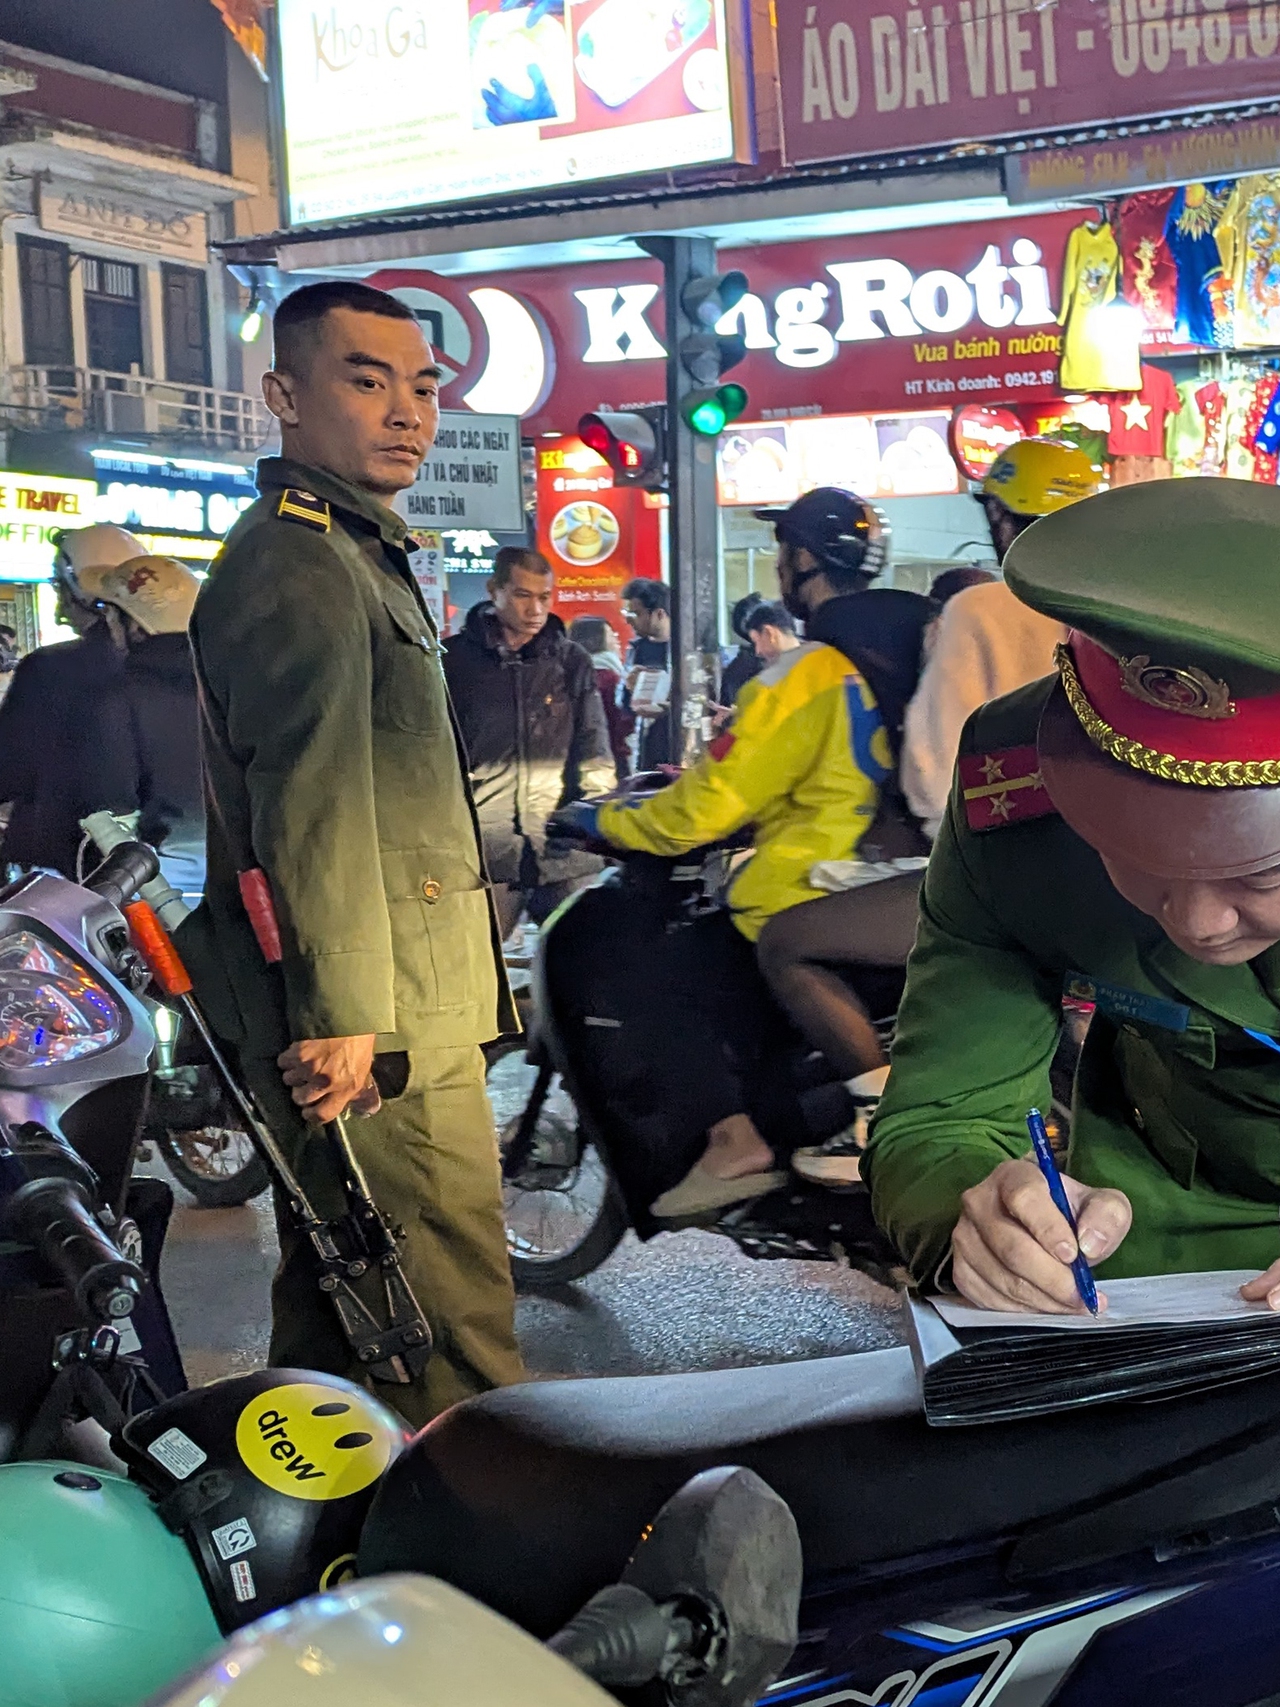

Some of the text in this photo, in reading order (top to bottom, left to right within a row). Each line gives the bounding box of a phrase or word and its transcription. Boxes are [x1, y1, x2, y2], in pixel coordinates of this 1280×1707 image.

[802, 5, 859, 123] ÁO
[870, 0, 950, 112] DÀI
[574, 237, 1060, 369] KngRoti
[914, 343, 948, 363] Vua
[954, 334, 1000, 360] bánh
[905, 380, 923, 395] HT
[926, 376, 954, 394] Kinh
[957, 374, 1001, 392] doanh:
[460, 427, 480, 450] CÁC
[483, 427, 509, 451] NGÀY
[433, 460, 446, 482] VÀ
[449, 456, 470, 483] CHỦ
[472, 461, 499, 487] NHẬT
[15, 488, 82, 514] TRAVEL
[408, 490, 466, 516] HÀNG TUẦN
[0, 523, 61, 546] FFIC
[257, 1409, 327, 1481] drew
